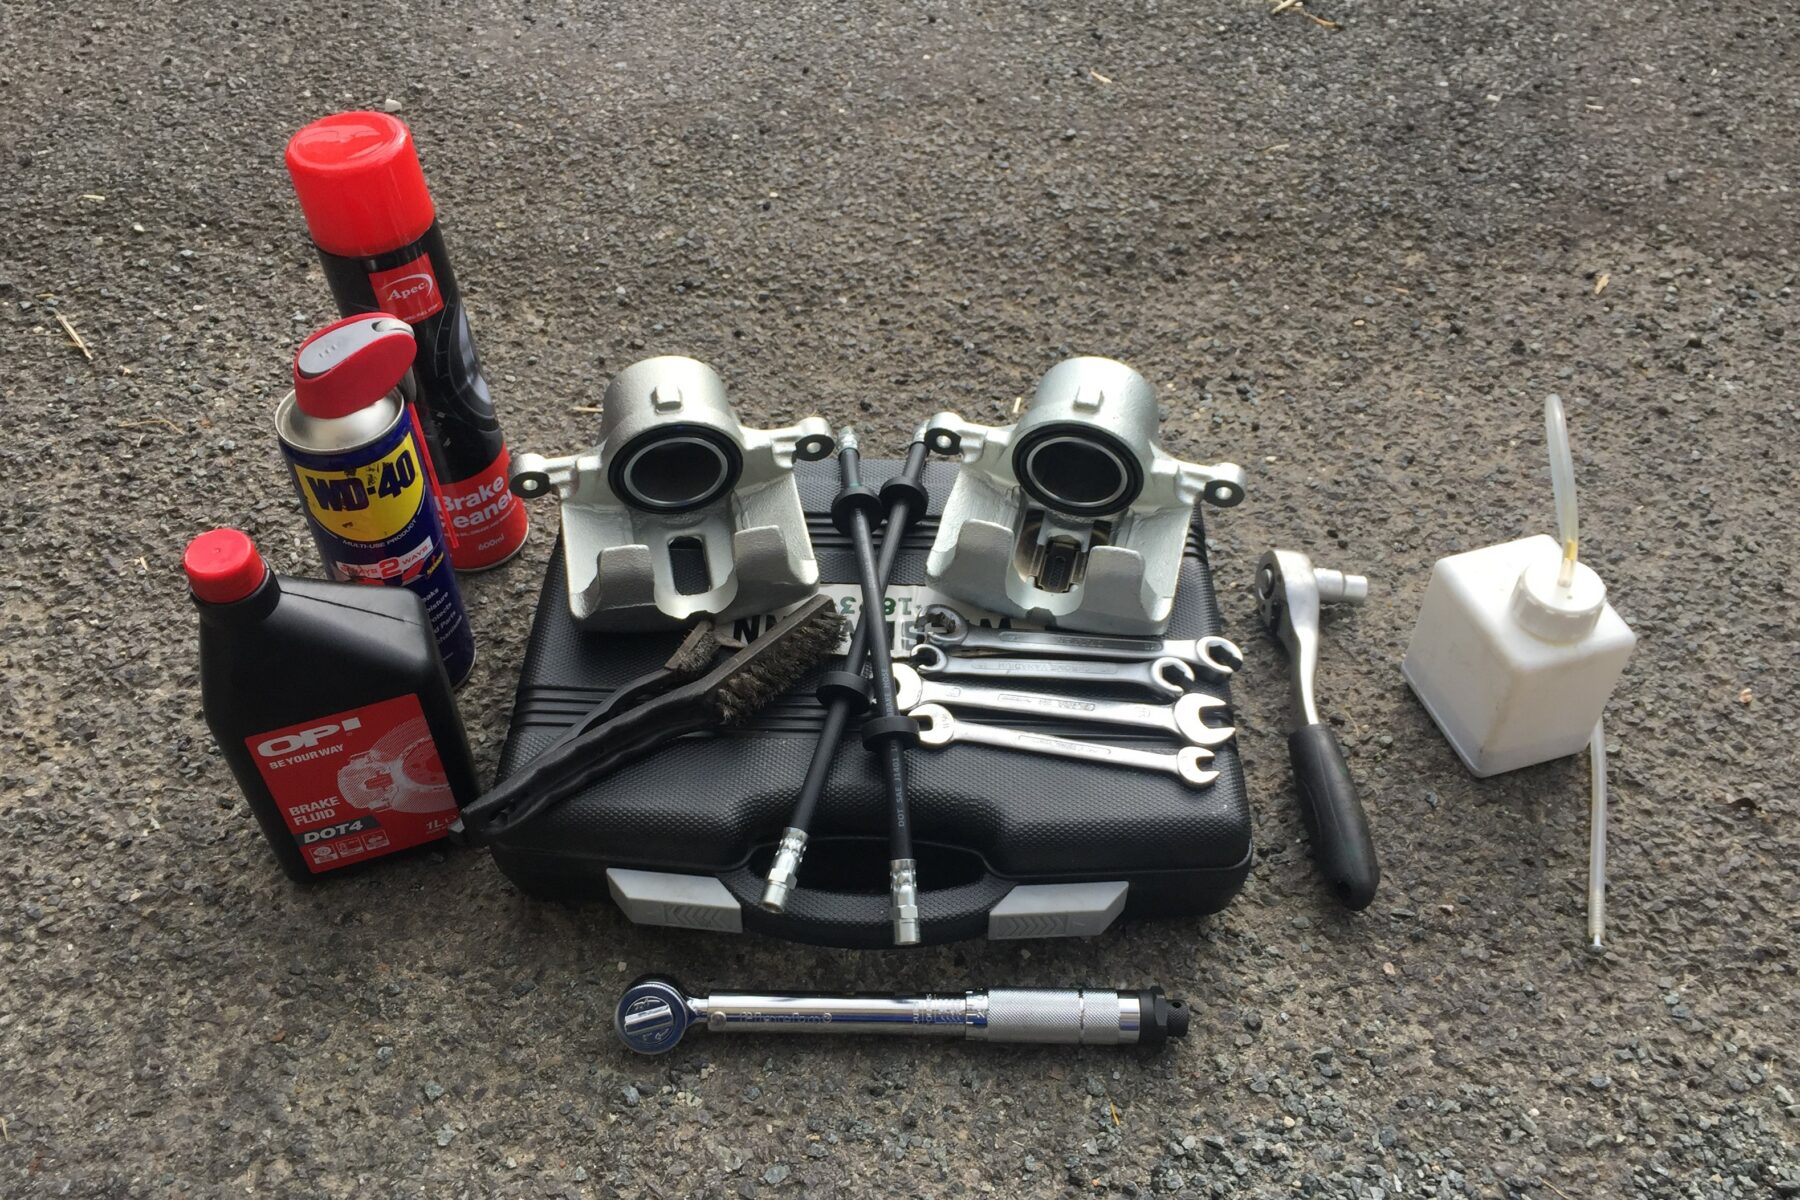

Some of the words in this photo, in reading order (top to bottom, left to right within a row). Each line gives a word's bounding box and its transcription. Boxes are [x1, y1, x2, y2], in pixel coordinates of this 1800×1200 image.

[386, 282, 426, 303] Apec
[305, 450, 416, 512] WD-40
[434, 476, 505, 512] Brake
[342, 538, 386, 549] MULTI-USE
[387, 519, 417, 545] PRODUCT
[379, 557, 402, 578] 2
[268, 759, 286, 770] BE
[285, 751, 319, 766] YOUR
[317, 743, 345, 757] WAY
[892, 758, 901, 782] J1401
[894, 785, 903, 804] SAE
[288, 796, 341, 817] BRAKE
[294, 809, 336, 827] FLUID
[897, 809, 905, 828] DOT
[303, 819, 364, 844] DOT4
